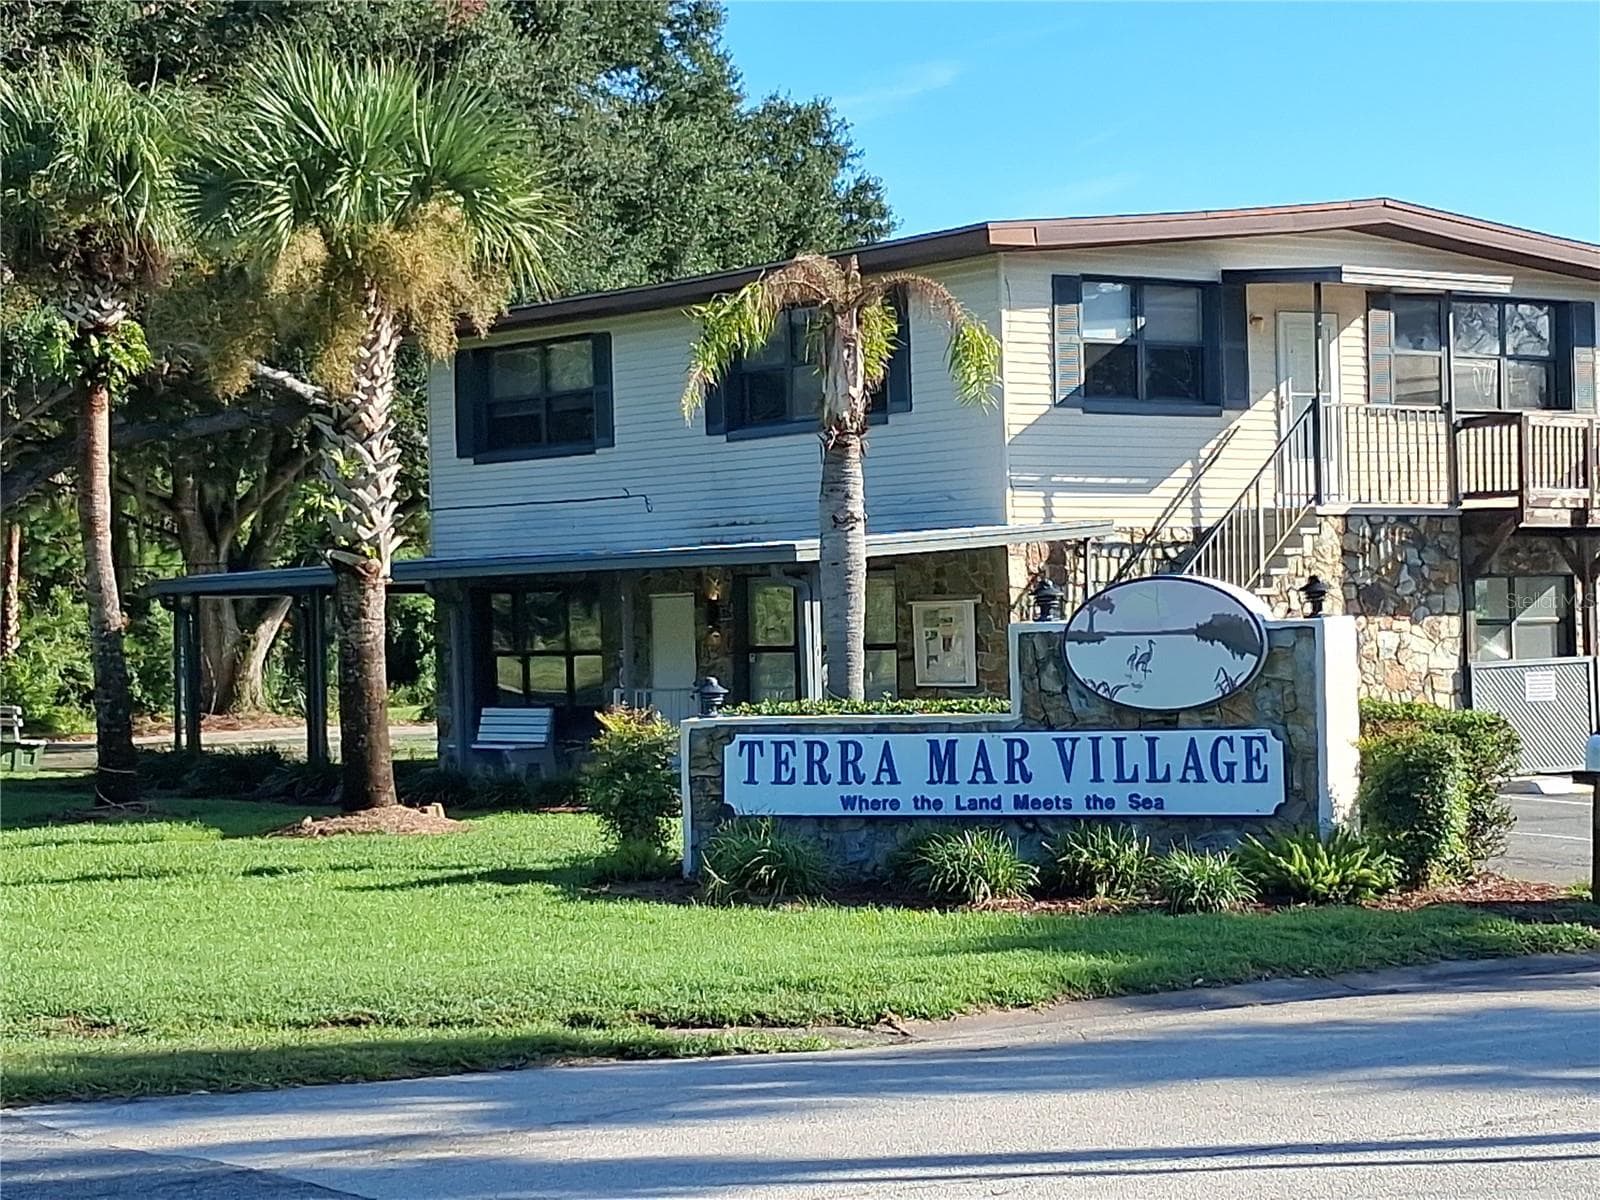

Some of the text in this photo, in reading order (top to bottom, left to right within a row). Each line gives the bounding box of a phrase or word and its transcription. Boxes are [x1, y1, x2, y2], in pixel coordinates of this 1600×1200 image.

[738, 735, 1269, 786] TERRA MAR VILLAGE
[840, 793, 1165, 812] Where the Land Meets the Sea
